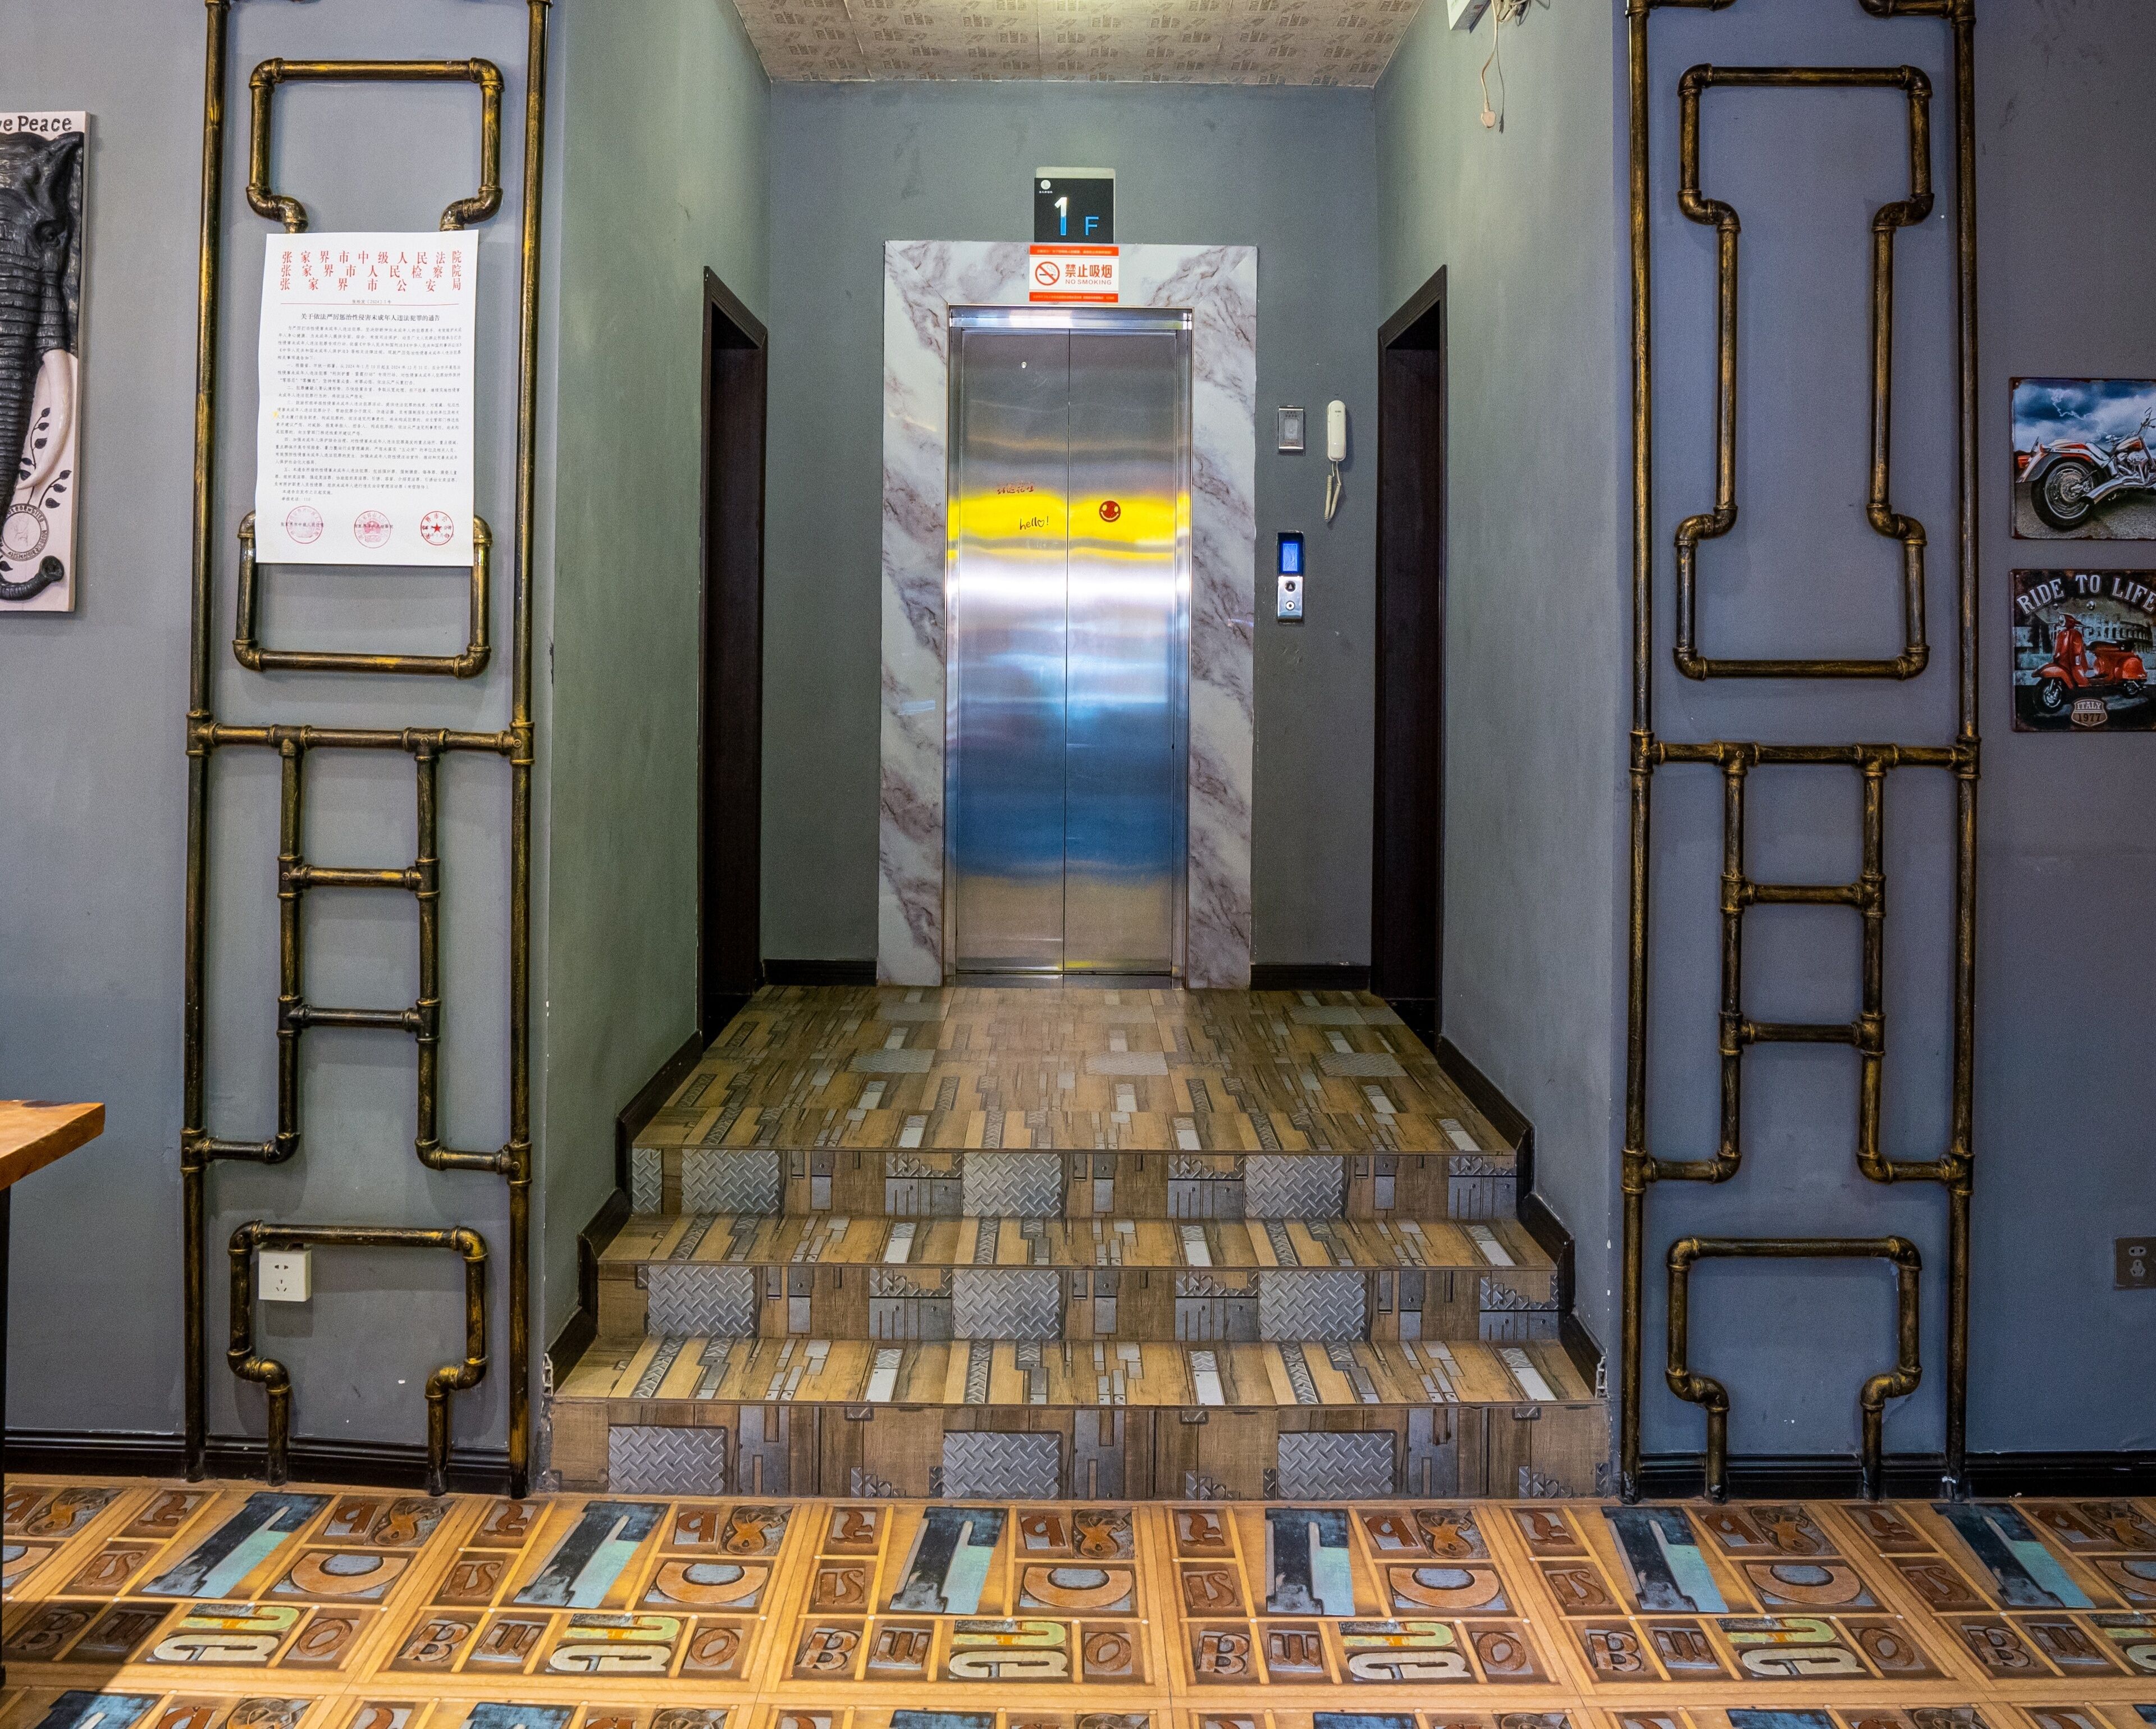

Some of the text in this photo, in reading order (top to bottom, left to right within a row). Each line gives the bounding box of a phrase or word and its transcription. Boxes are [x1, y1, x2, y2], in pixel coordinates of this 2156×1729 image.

[17, 116, 72, 131] Peace
[282, 250, 462, 264] 张家界市中级人民法院
[281, 264, 462, 279] 张家界市人民检察院
[1065, 264, 1112, 278] 禁止吸烟
[280, 277, 461, 292] 张家界市公安局
[2017, 574, 2156, 614] RIDE TO LIFE
[2077, 701, 2102, 709] ITALY
[2078, 714, 2100, 722] 1977
